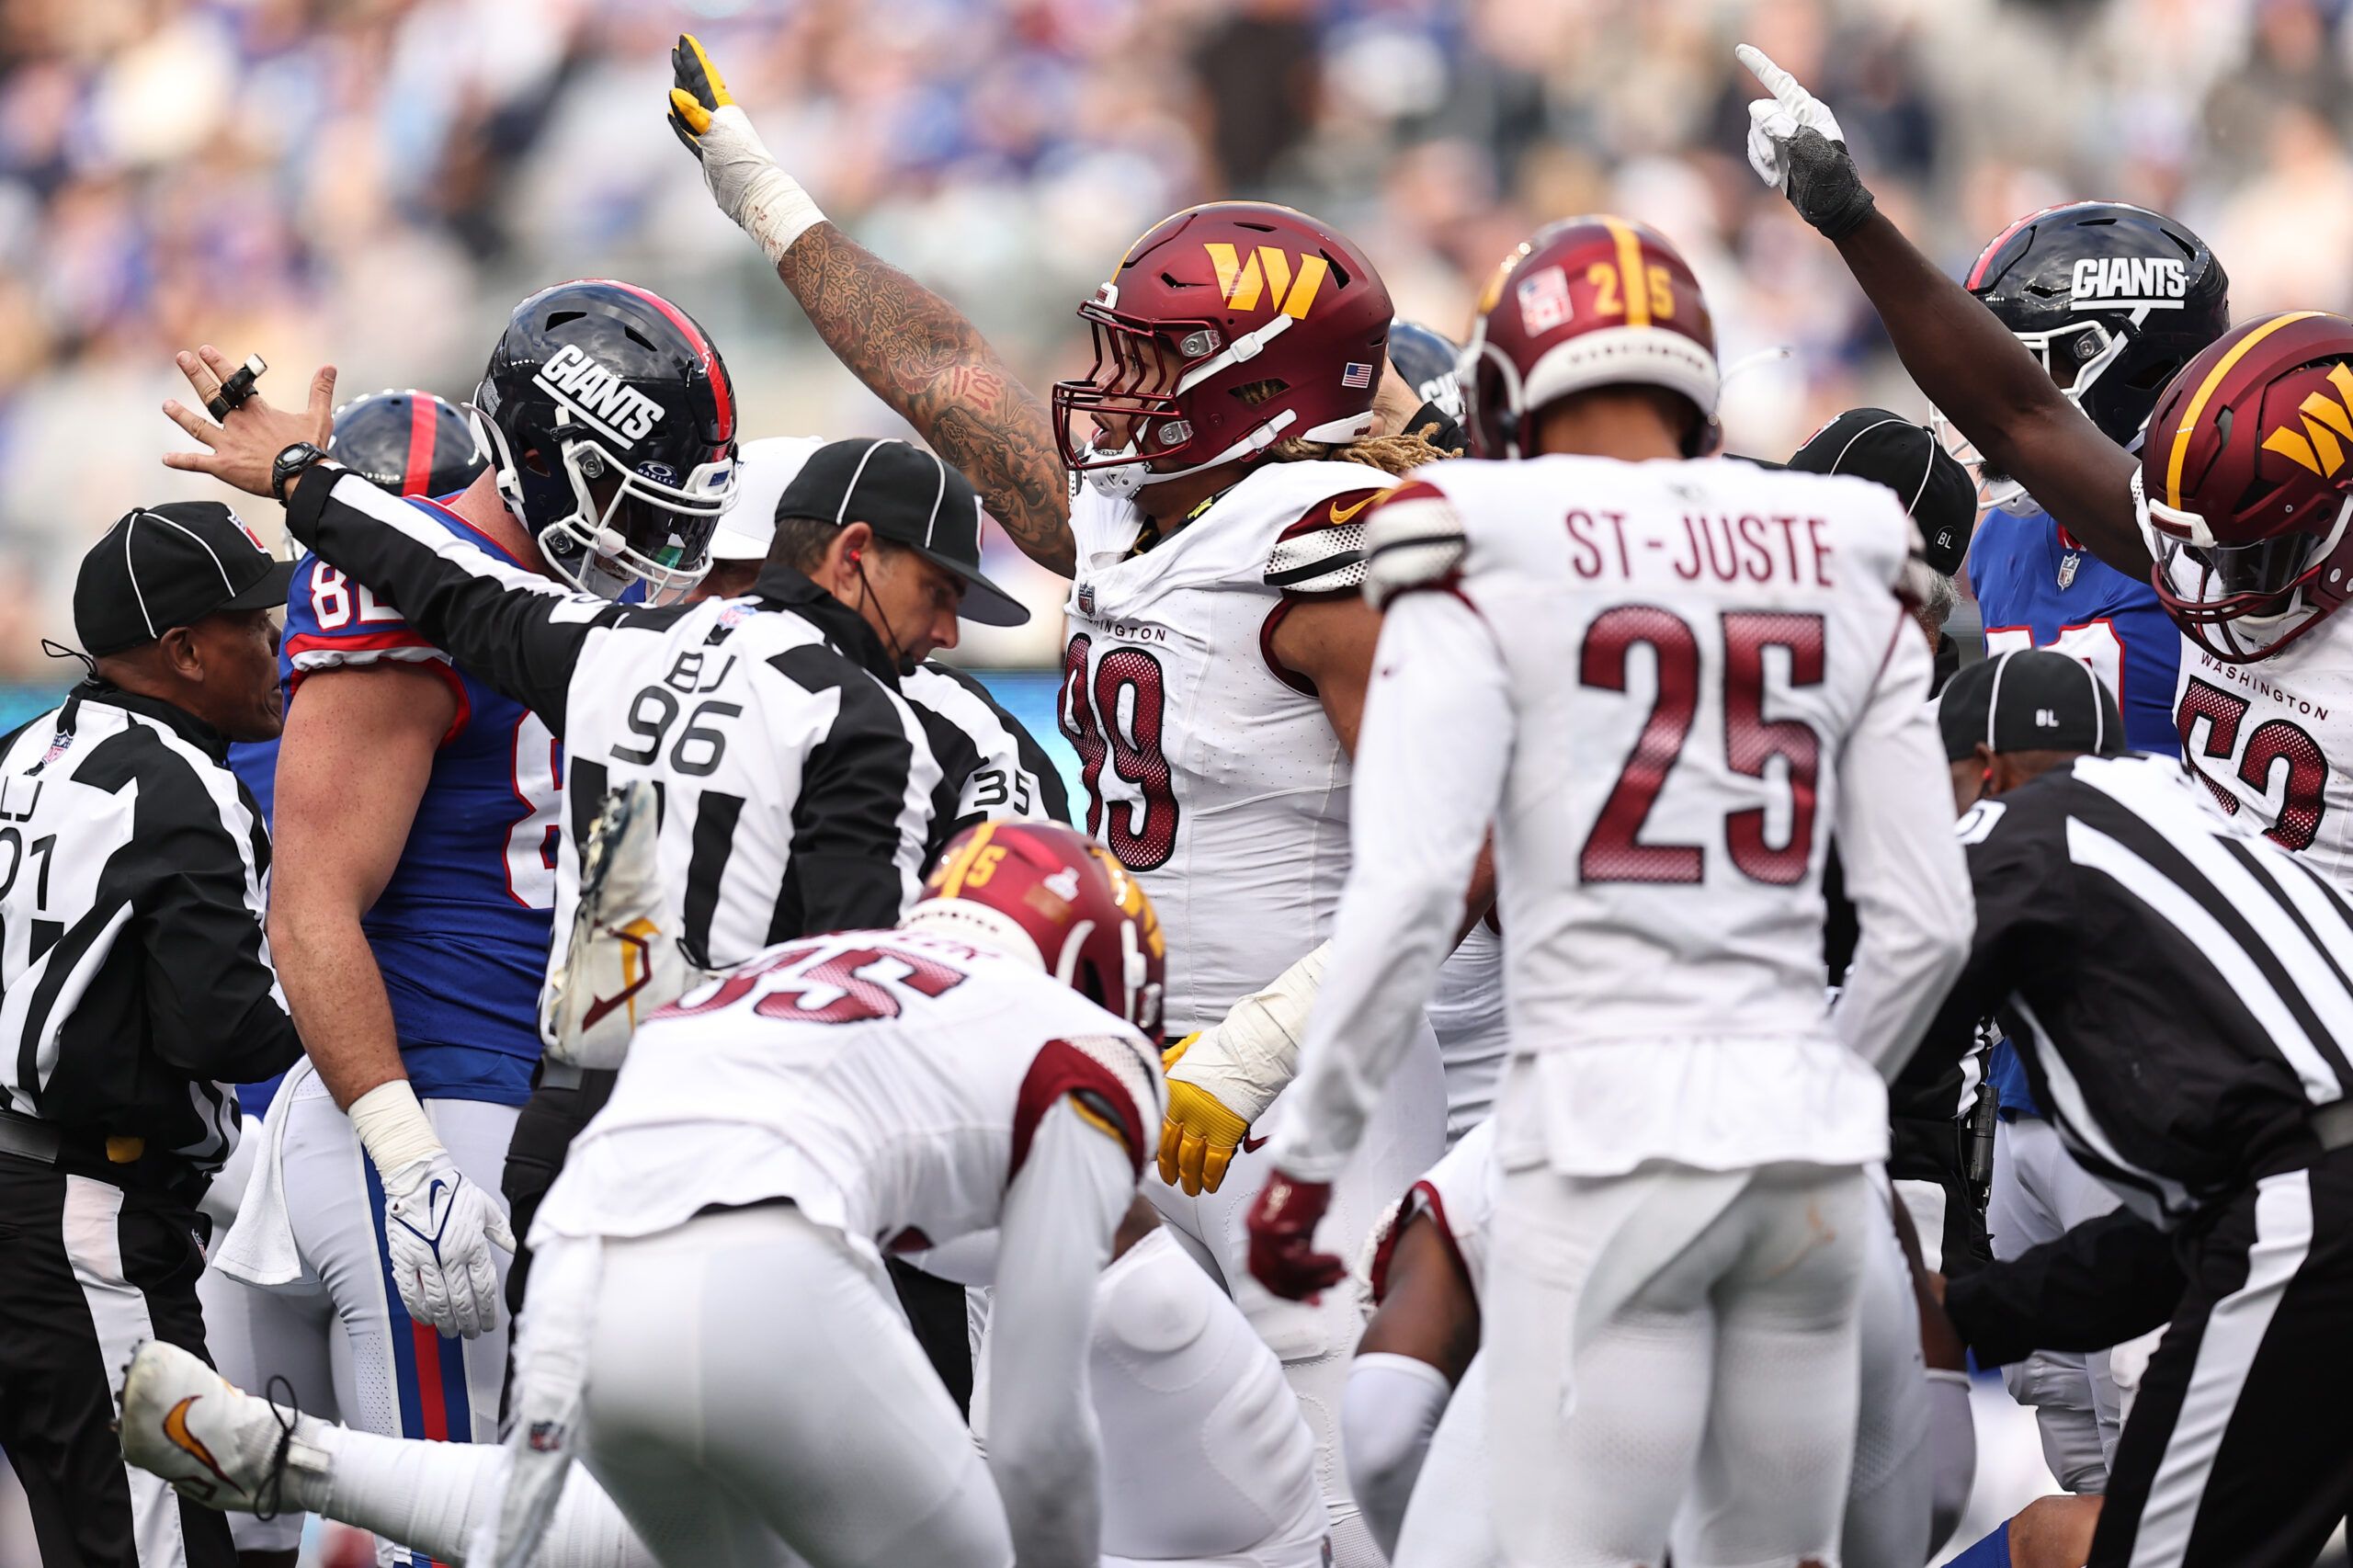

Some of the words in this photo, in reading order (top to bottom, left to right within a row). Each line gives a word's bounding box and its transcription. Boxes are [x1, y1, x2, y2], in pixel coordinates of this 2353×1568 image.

[2071, 257, 2186, 298] GIANTS
[540, 344, 665, 440] GIANTS
[637, 468, 675, 484] OAKLEY
[1565, 509, 1835, 587] ST-JUSTE
[1937, 531, 1951, 549] BL
[664, 651, 737, 694] BJ
[2200, 652, 2328, 721] WASHINGTON
[609, 686, 744, 777] 96
[2035, 708, 2060, 727] BL
[1577, 603, 1825, 885] 25
[973, 769, 1031, 816] 35
